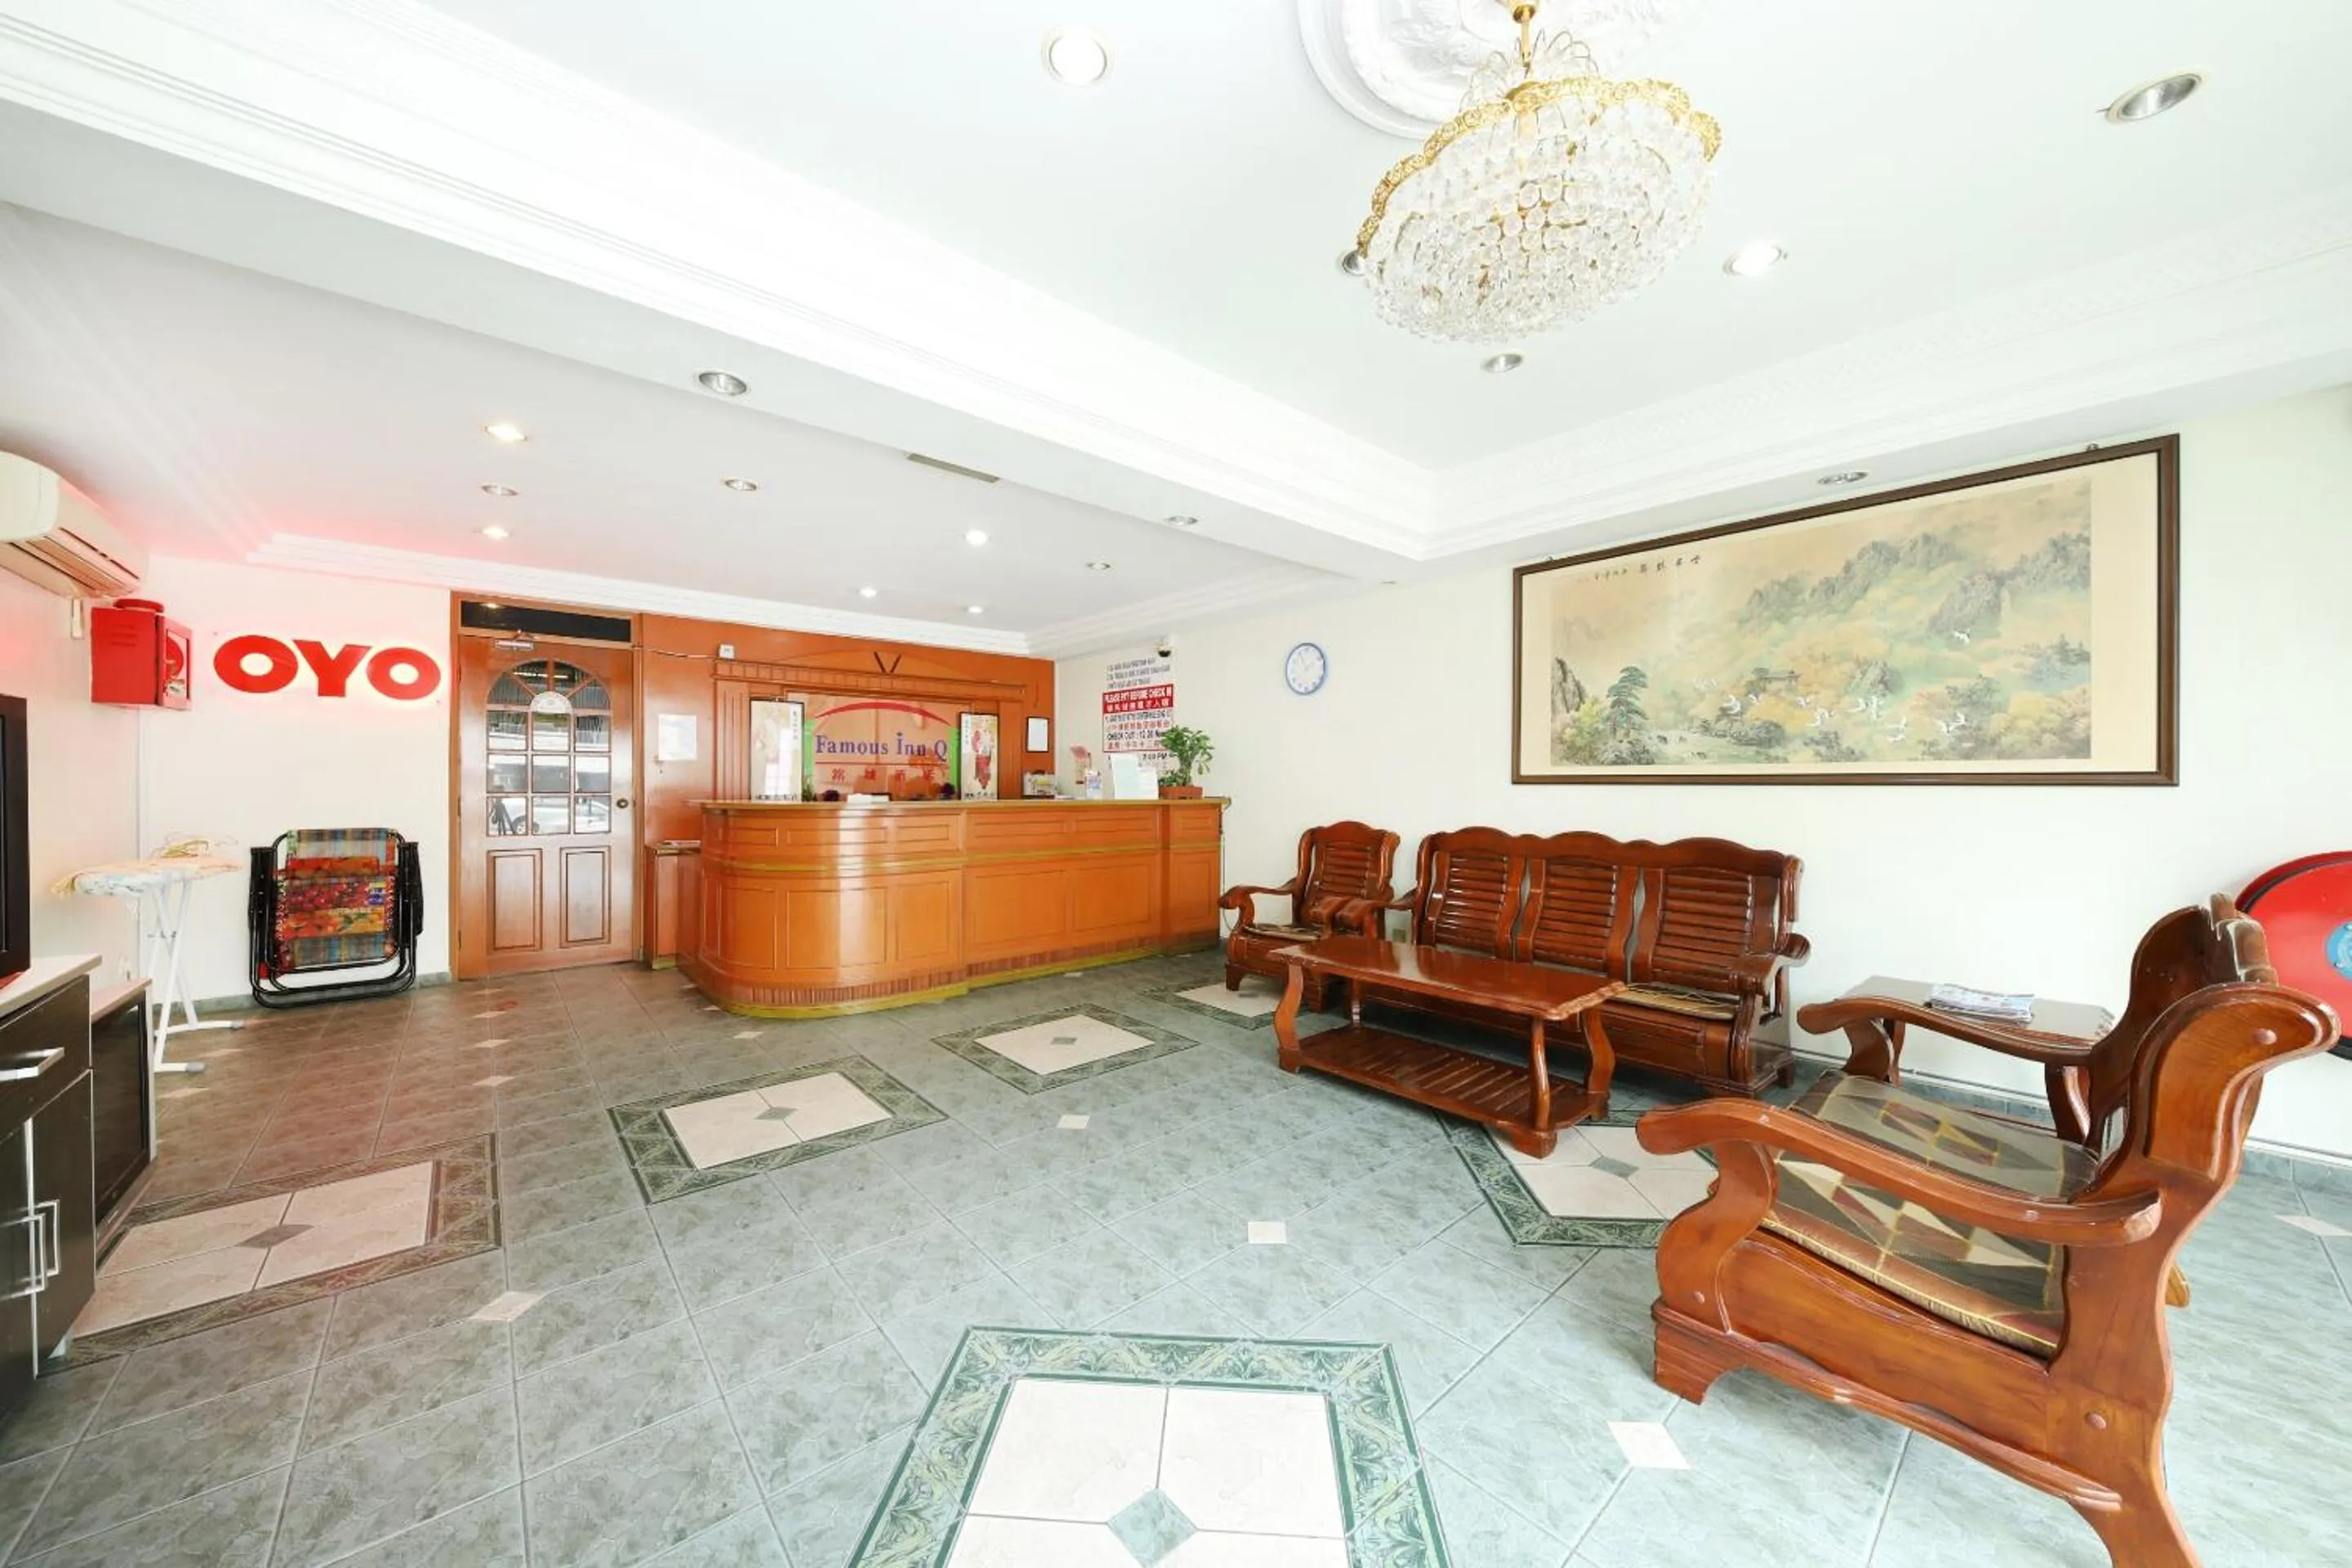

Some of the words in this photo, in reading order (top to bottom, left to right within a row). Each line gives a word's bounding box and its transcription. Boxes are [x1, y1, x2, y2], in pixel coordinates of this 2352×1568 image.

[213, 635, 441, 701] OYO
[815, 735, 889, 755] Famous
[896, 732, 926, 756] Inn
[933, 739, 948, 762] Q
